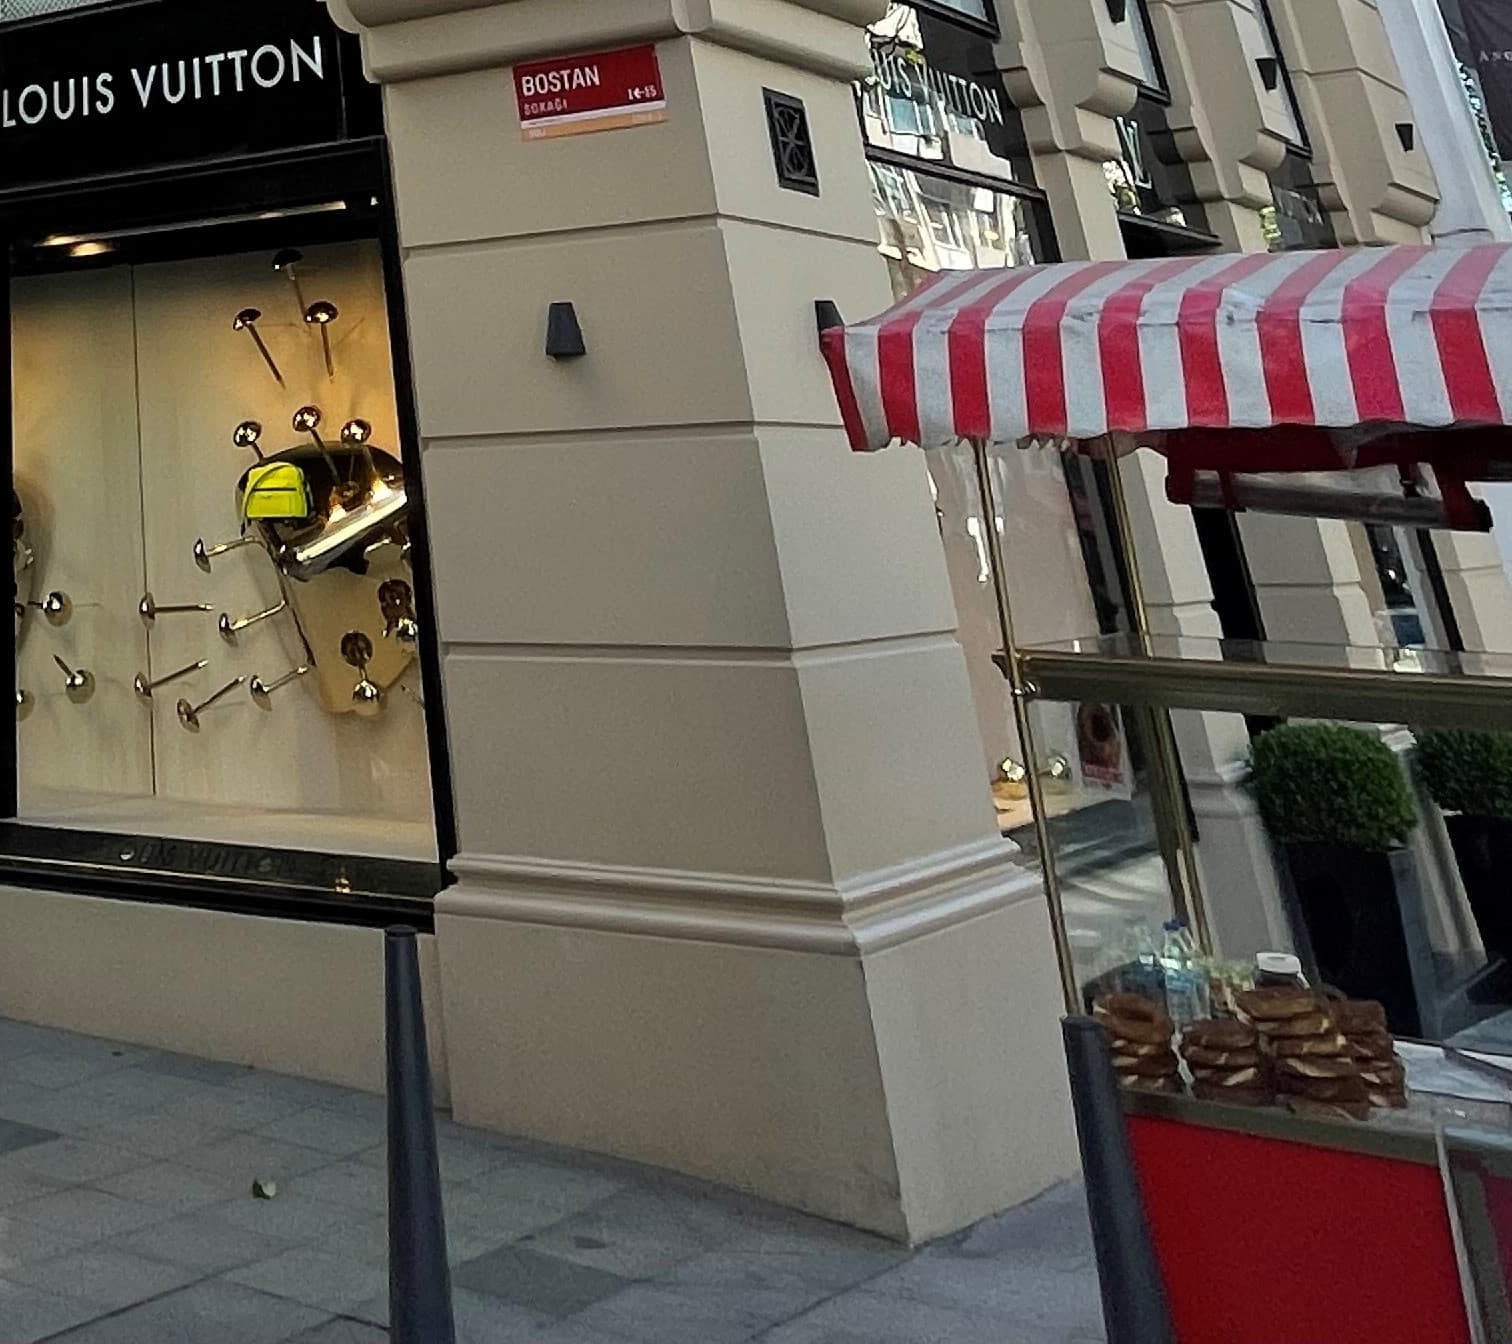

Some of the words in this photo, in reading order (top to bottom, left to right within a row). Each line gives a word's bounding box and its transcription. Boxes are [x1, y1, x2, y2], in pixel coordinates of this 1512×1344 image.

[2, 72, 115, 128] LOUIS
[130, 35, 324, 109] VUITTON
[521, 64, 601, 97] BOSTAN
[914, 60, 1004, 127] VUITTON
